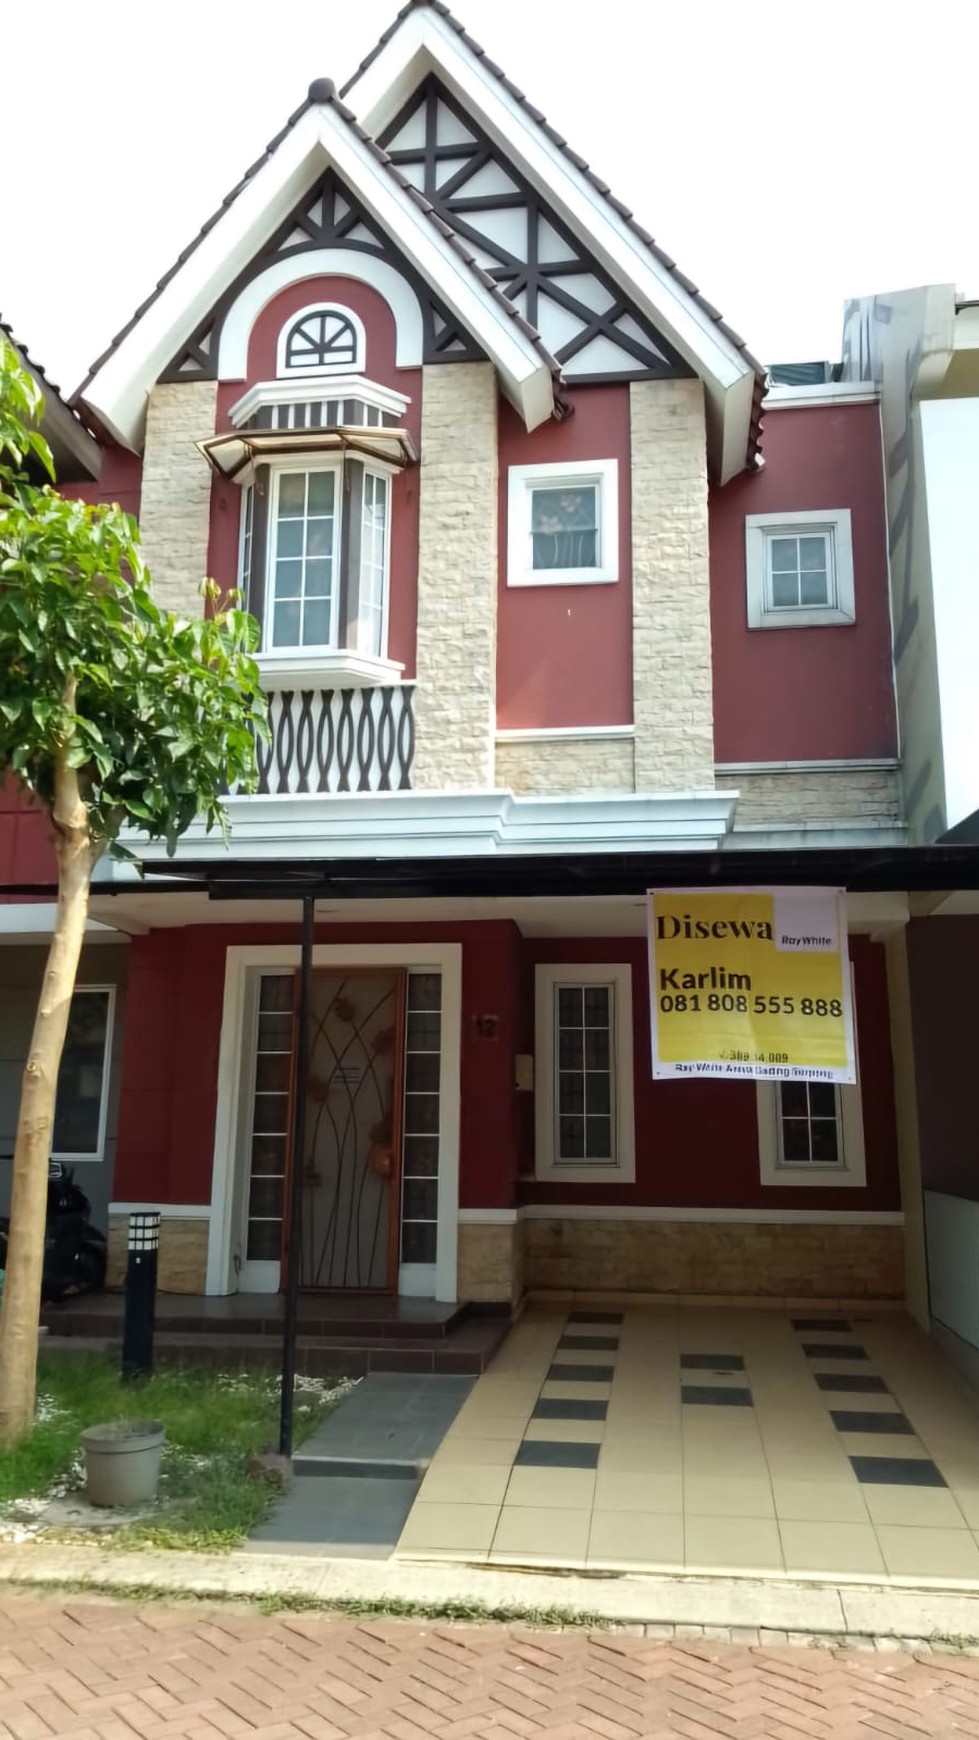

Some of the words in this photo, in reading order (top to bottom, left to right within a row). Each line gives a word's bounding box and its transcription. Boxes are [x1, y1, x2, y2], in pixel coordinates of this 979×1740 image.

[656, 914, 773, 940] Disewa
[781, 935, 800, 946] Ray
[802, 935, 832, 946] White
[660, 966, 751, 991] Karlim
[660, 994, 702, 1013] 081
[707, 994, 748, 1012] 808
[753, 996, 795, 1014] 555
[800, 998, 842, 1017] 888
